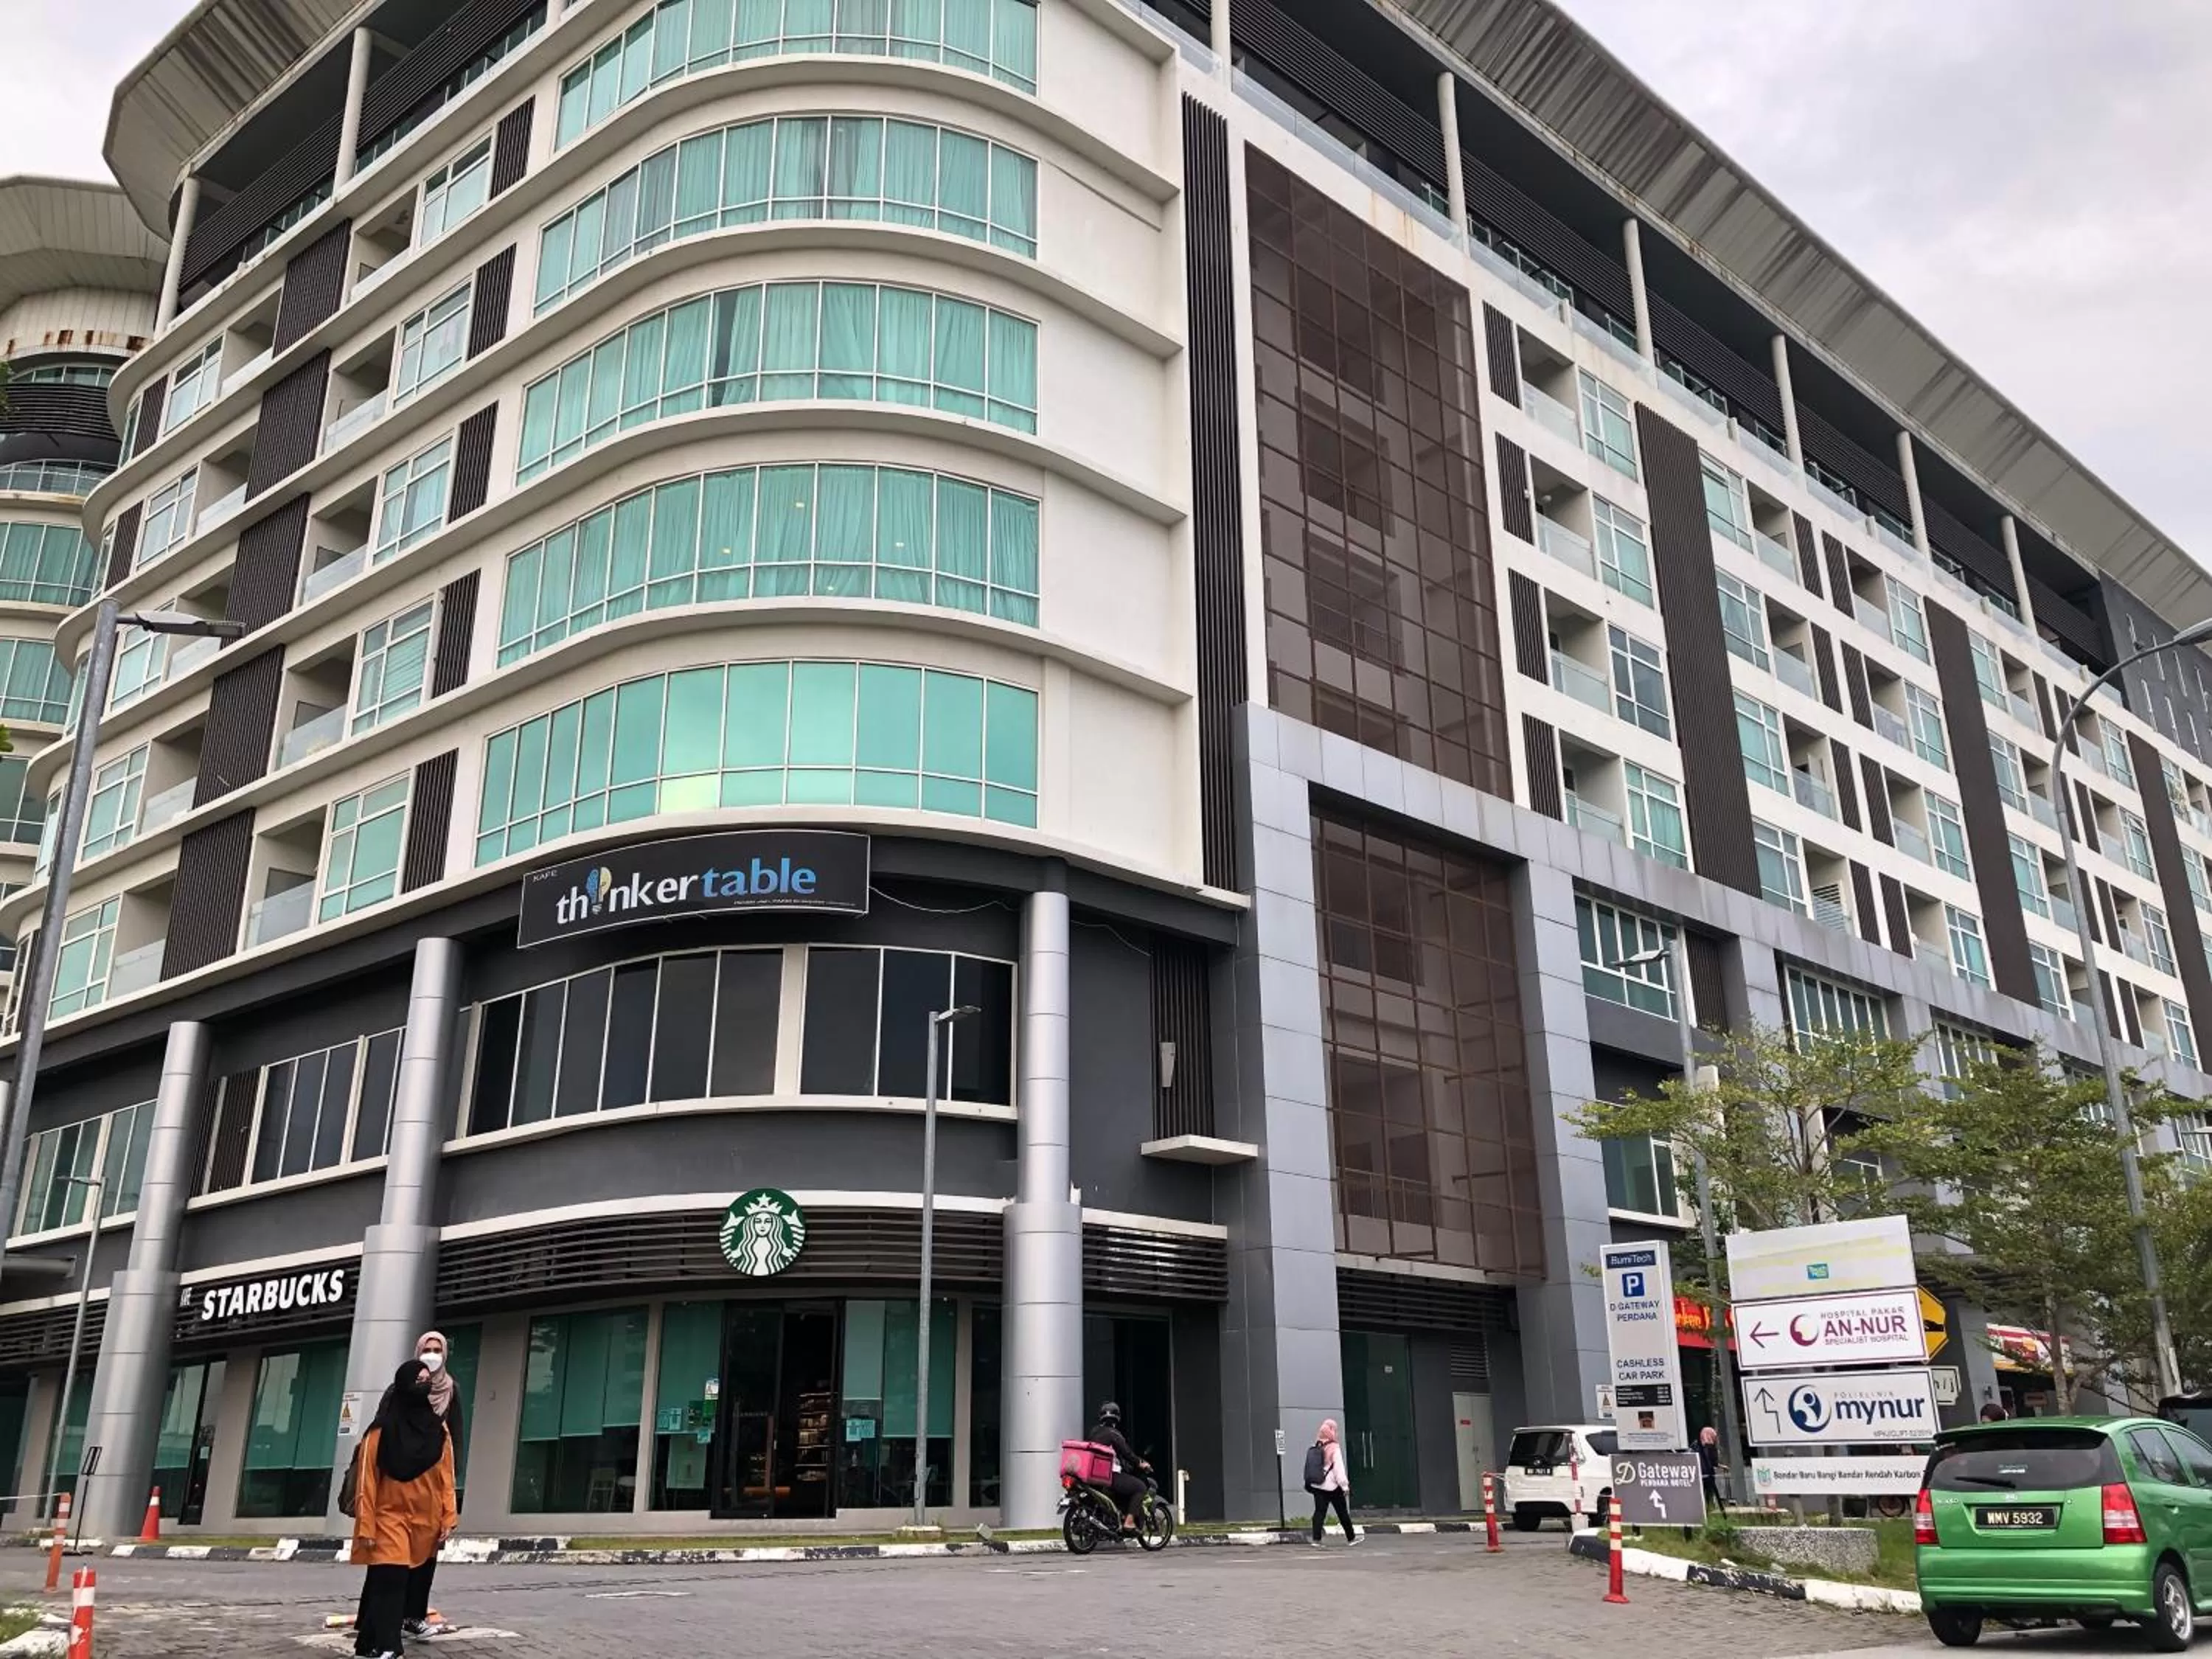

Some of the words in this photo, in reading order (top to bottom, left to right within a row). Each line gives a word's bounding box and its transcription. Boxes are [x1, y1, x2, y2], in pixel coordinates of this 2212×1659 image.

[532, 870, 557, 883] KAFE
[1626, 1275, 1639, 1295] P
[201, 1269, 344, 1321] STARBUCKS
[1618, 1300, 1660, 1310] GATEWAY
[1617, 1312, 1658, 1322] PERDANA
[1820, 1309, 1867, 1319] HOSPITAL
[1871, 1306, 1905, 1315] PAKAR
[1824, 1315, 1907, 1337] AN-NUR
[1824, 1336, 1868, 1346] SPECIALIST
[1870, 1334, 1909, 1343] HOSPITAL
[1616, 1357, 1664, 1368] CASHLESS
[1618, 1371, 1638, 1381] CAR
[1640, 1370, 1664, 1380] PARK
[1835, 1398, 1924, 1425] mynur
[1638, 1461, 1696, 1483] Gateway
[1773, 1470, 1798, 1479] Bandar
[1817, 1470, 1837, 1481] Bangi
[1894, 1470, 1921, 1478] Karbon
[1987, 1512, 2009, 1524] WMV
[2012, 1512, 2044, 1524] 5932
